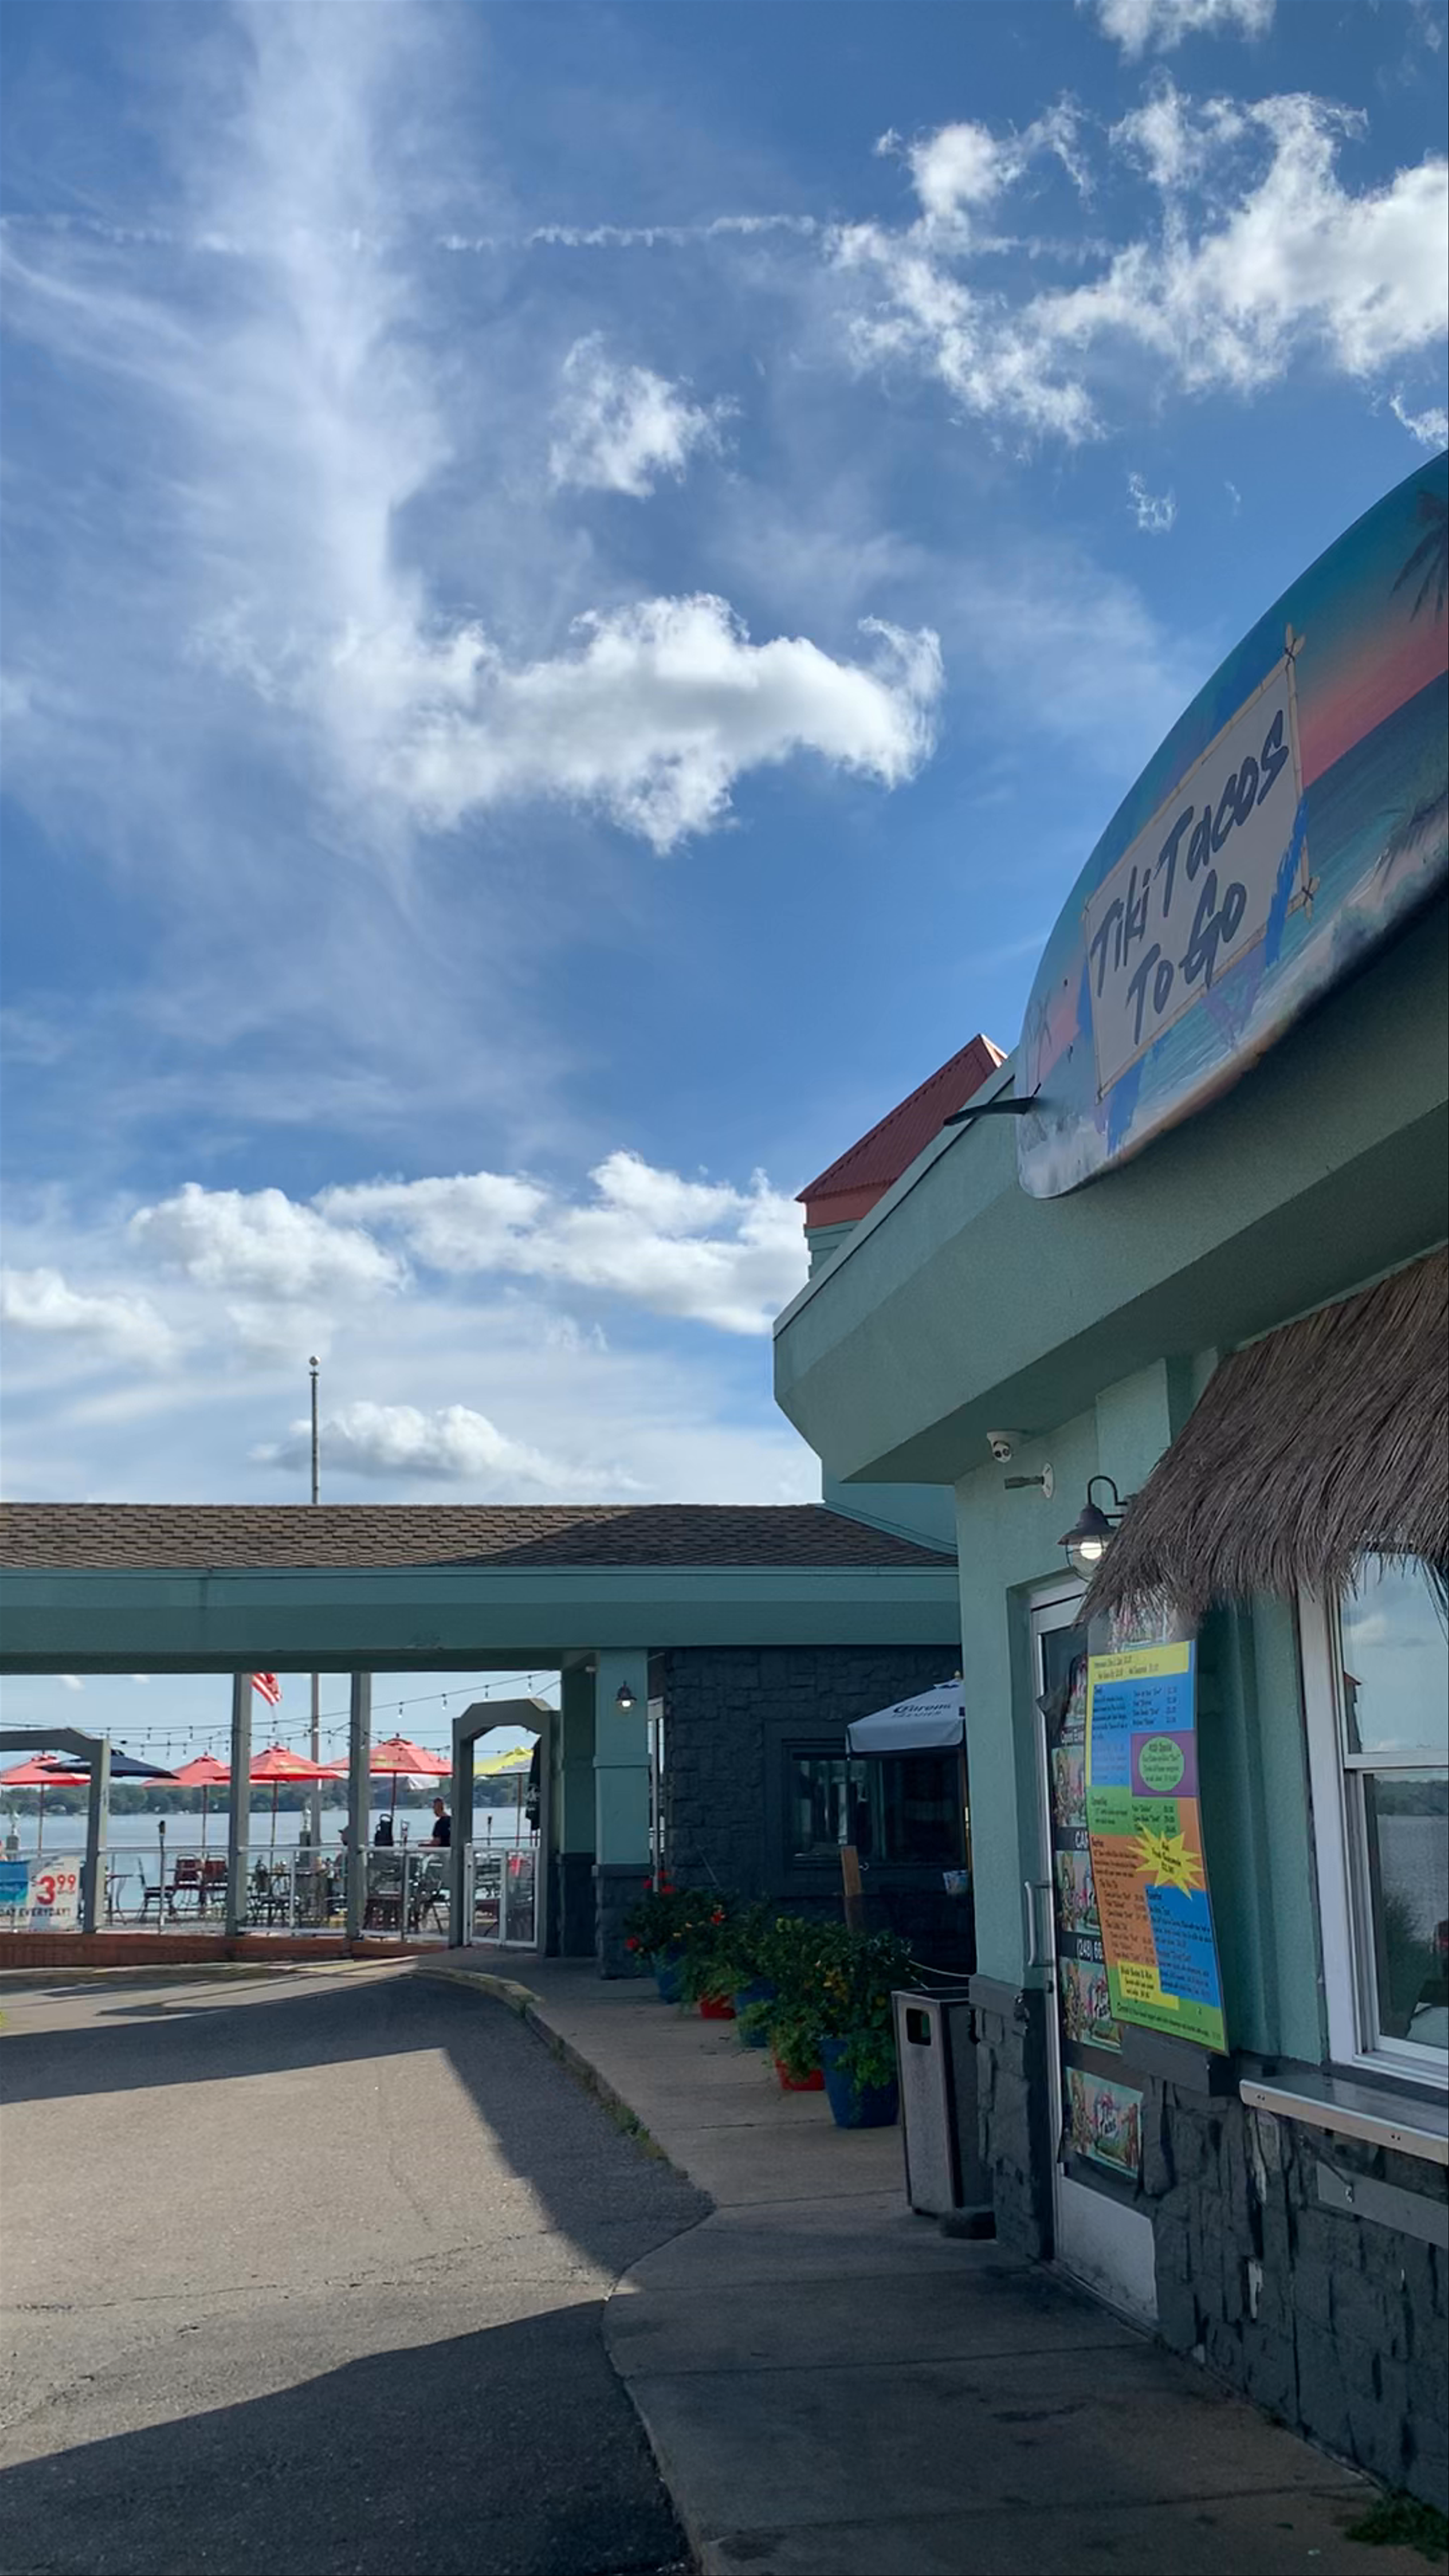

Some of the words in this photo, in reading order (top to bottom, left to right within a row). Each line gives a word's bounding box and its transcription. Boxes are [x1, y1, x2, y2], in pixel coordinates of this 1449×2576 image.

[1090, 865, 1152, 997] Tiki
[1154, 709, 1289, 918] Tacos
[1125, 943, 1174, 1046] To
[1179, 869, 1247, 989] Go
[893, 1704, 951, 1713] Corona
